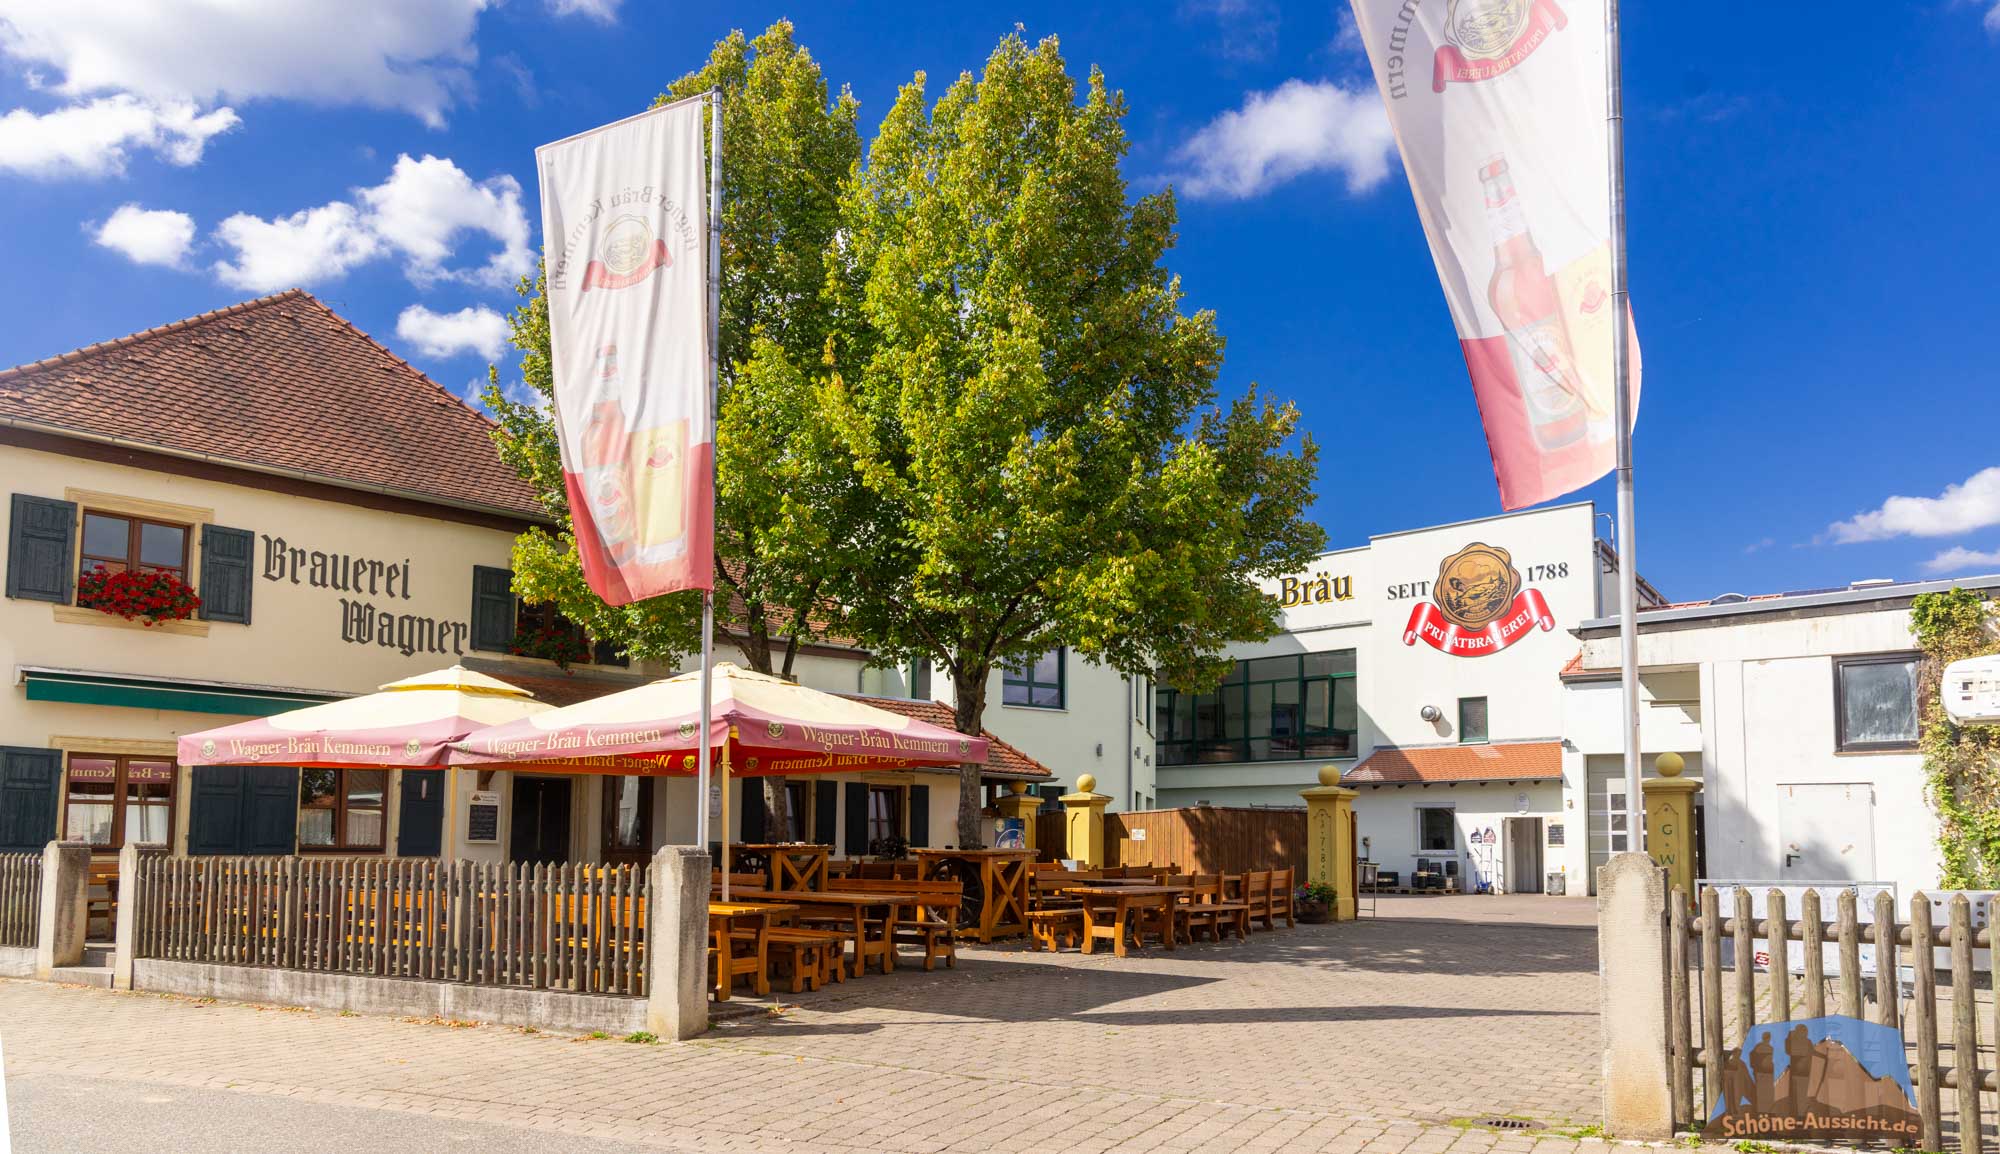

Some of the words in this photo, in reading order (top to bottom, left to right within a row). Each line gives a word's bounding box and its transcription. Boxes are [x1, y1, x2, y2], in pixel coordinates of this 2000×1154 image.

[261, 534, 411, 600] Brauerei
[1387, 580, 1430, 600] SEIT
[1527, 562, 1569, 582] 1788
[339, 598, 467, 657] Wagner
[1424, 609, 1531, 649] PRIVATBRAUEREI
[230, 735, 320, 760] Wagner-Bräu
[323, 736, 391, 756] Kemmern
[487, 728, 581, 758] Wagner-Bräu
[585, 728, 662, 748] Kemmern
[800, 725, 890, 751] Wagner-Bräu
[893, 733, 949, 753] Kemmern
